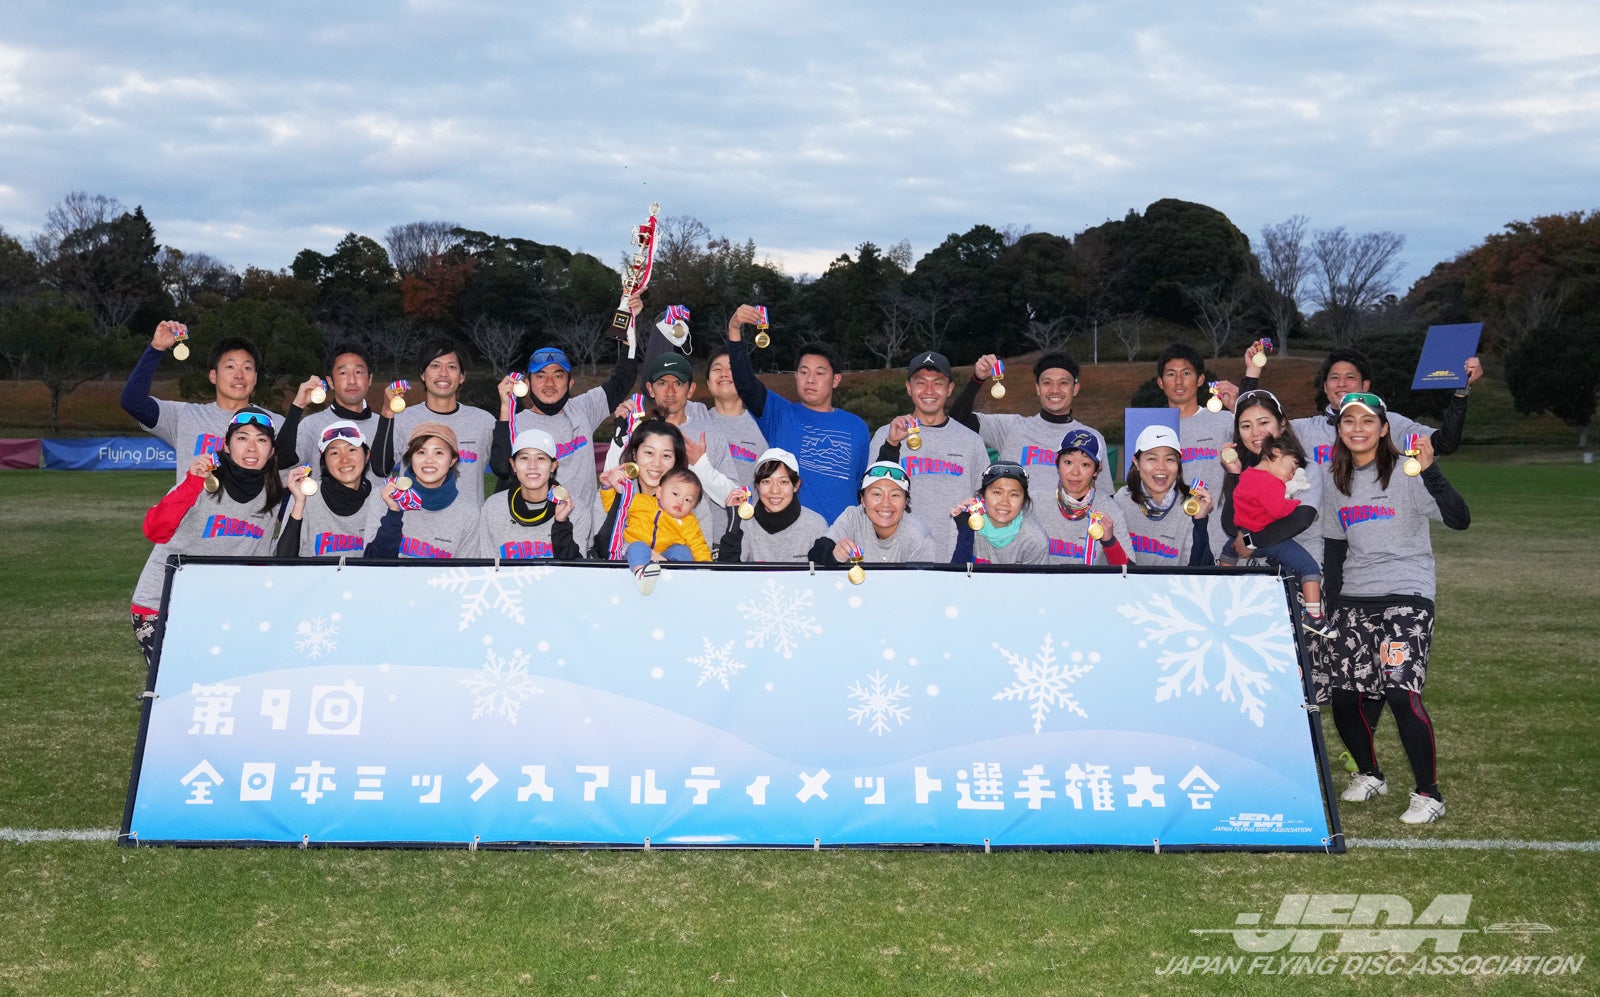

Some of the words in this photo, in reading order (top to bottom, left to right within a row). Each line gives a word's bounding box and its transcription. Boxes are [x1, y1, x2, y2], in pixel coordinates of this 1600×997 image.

[99, 447, 142, 465] Flying
[146, 447, 174, 460] Disc
[901, 456, 964, 477] FIREMAN
[203, 514, 264, 539] FIREMAN
[1338, 505, 1395, 534] FIREMAN
[399, 534, 452, 558] IREMAN
[187, 682, 365, 735] 第9回
[179, 758, 1221, 811] 全日本ミックスアルティメット選手権大会
[1229, 812, 1284, 828] JFDA
